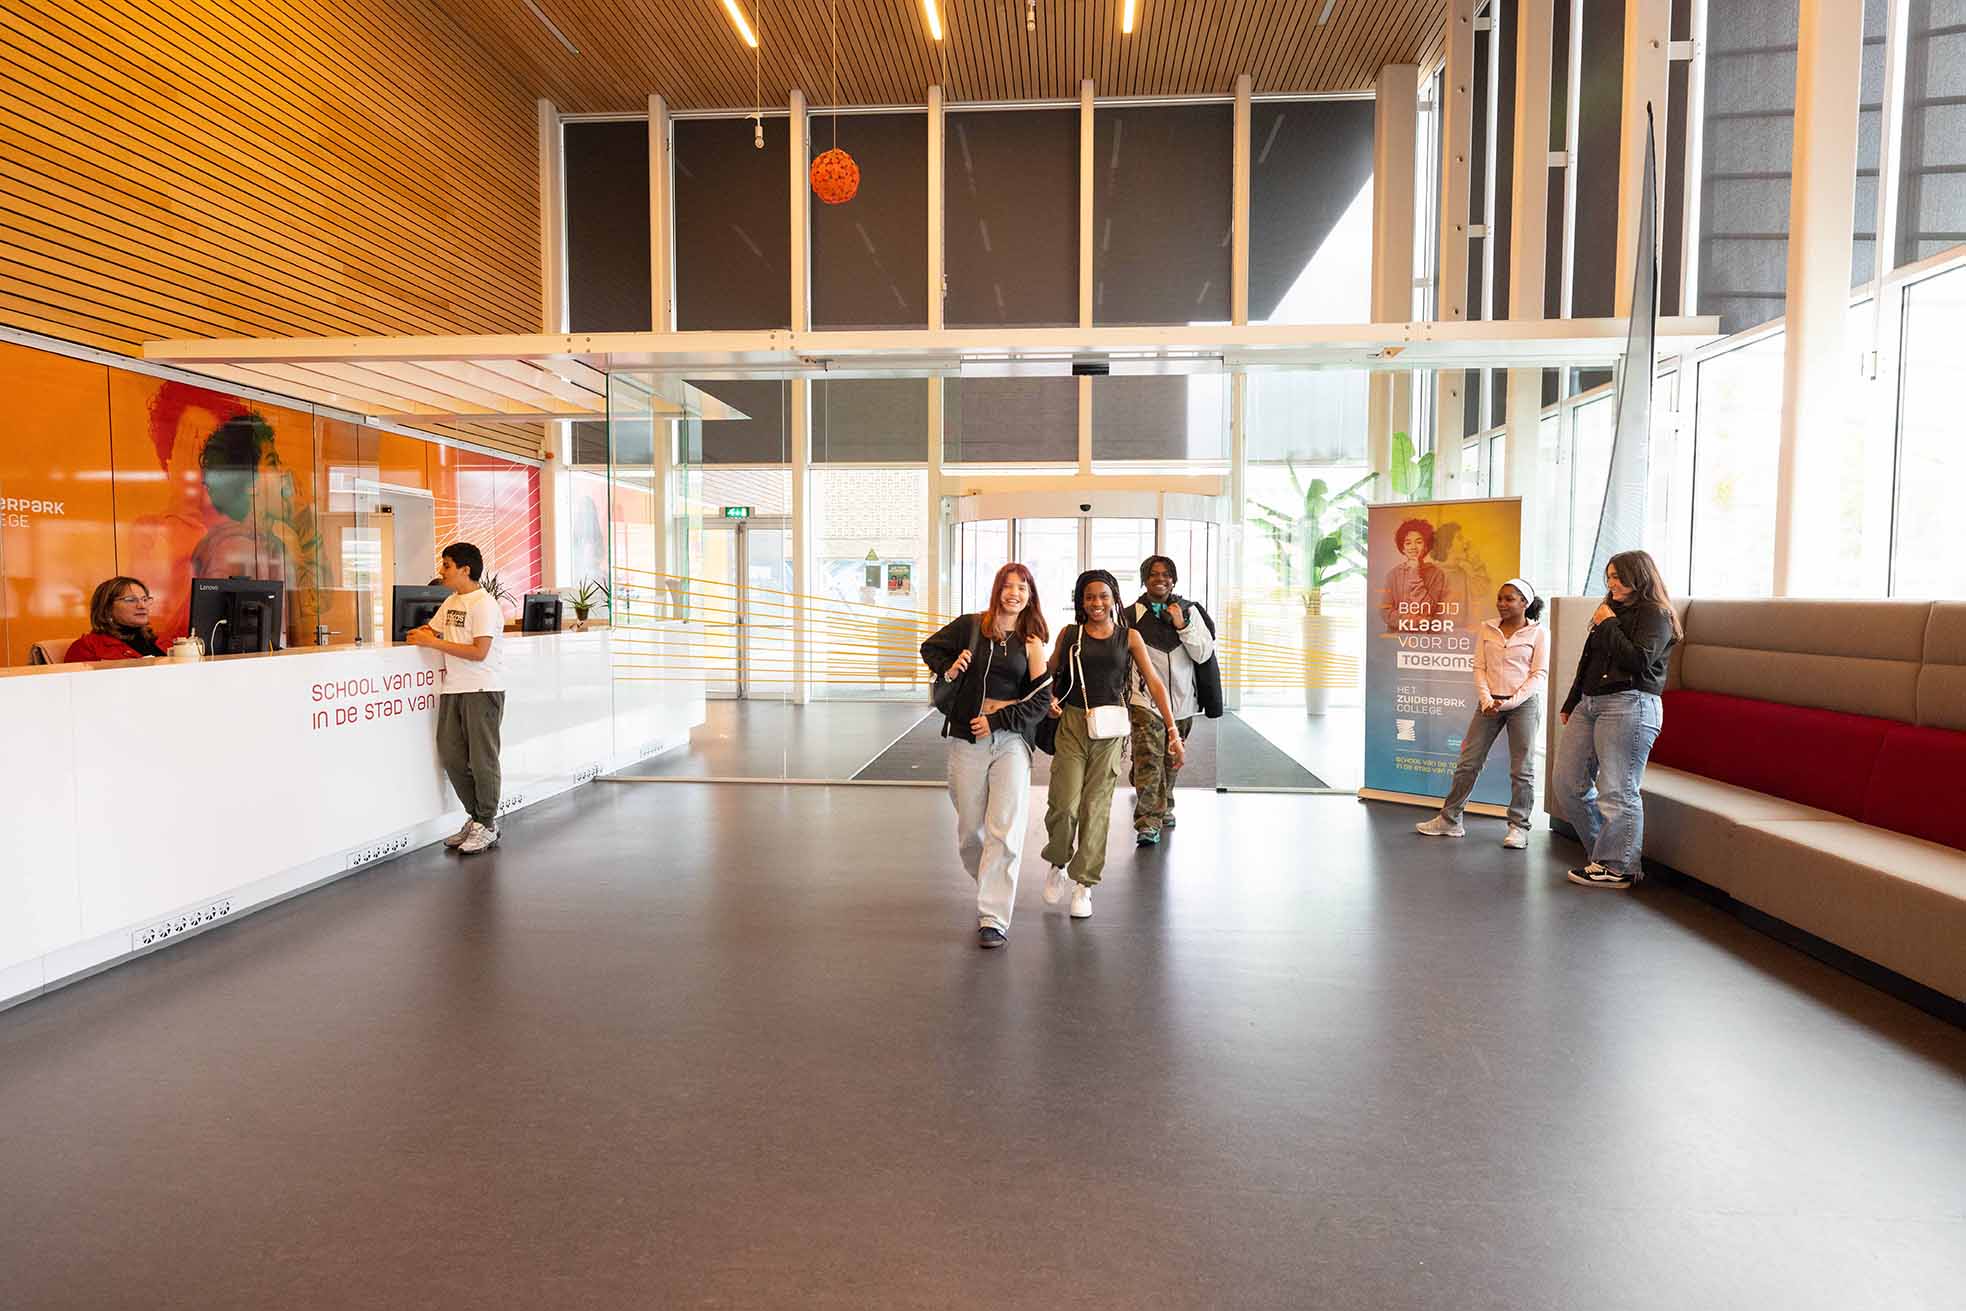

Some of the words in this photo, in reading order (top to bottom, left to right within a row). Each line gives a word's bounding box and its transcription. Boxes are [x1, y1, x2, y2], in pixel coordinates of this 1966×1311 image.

[1398, 636, 1442, 649] VOOR
[312, 678, 379, 702] SCHOOL
[383, 673, 412, 691] van
[408, 694, 435, 712] van
[1396, 704, 1442, 715] COLLEGE
